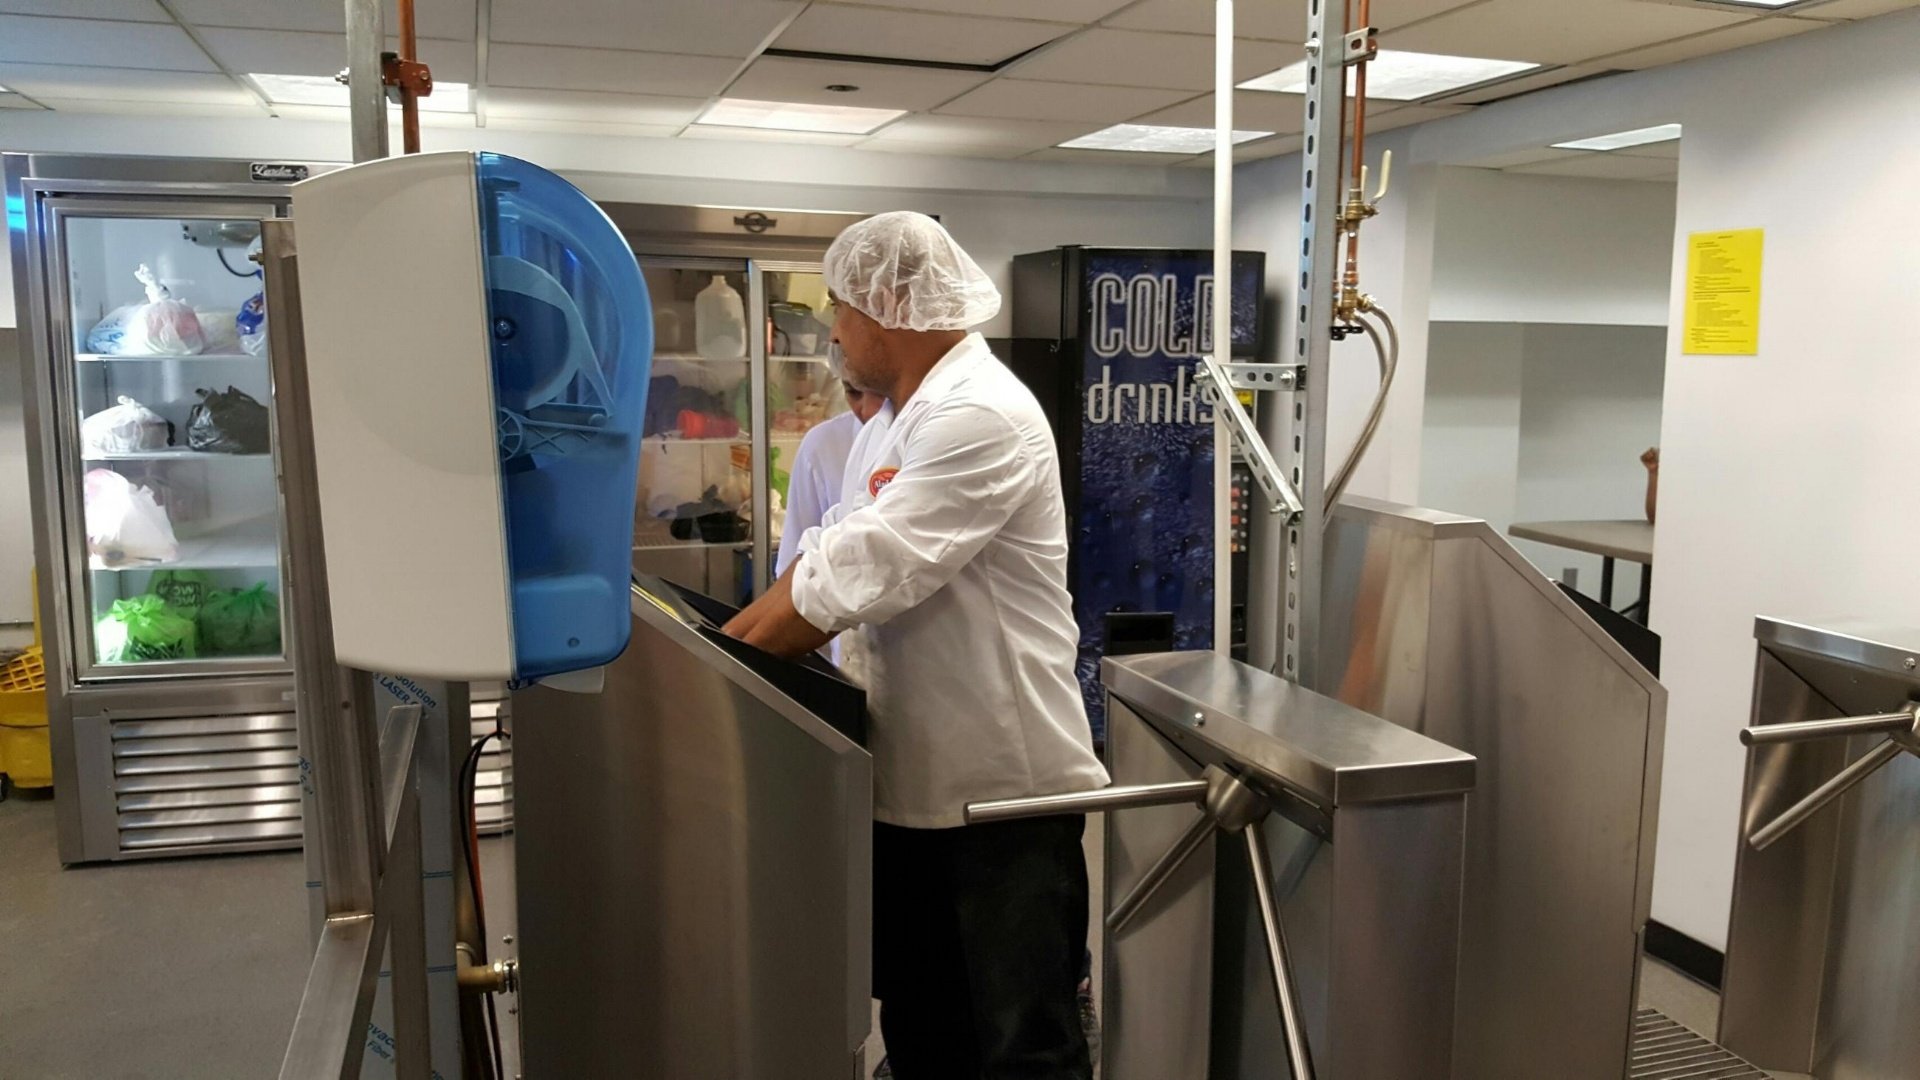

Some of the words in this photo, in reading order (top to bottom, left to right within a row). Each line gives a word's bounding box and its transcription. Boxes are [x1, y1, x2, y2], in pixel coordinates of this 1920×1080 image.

[1091, 273, 1215, 358] COLD
[1088, 365, 1215, 426] drinks
[380, 676, 410, 704] LASER
